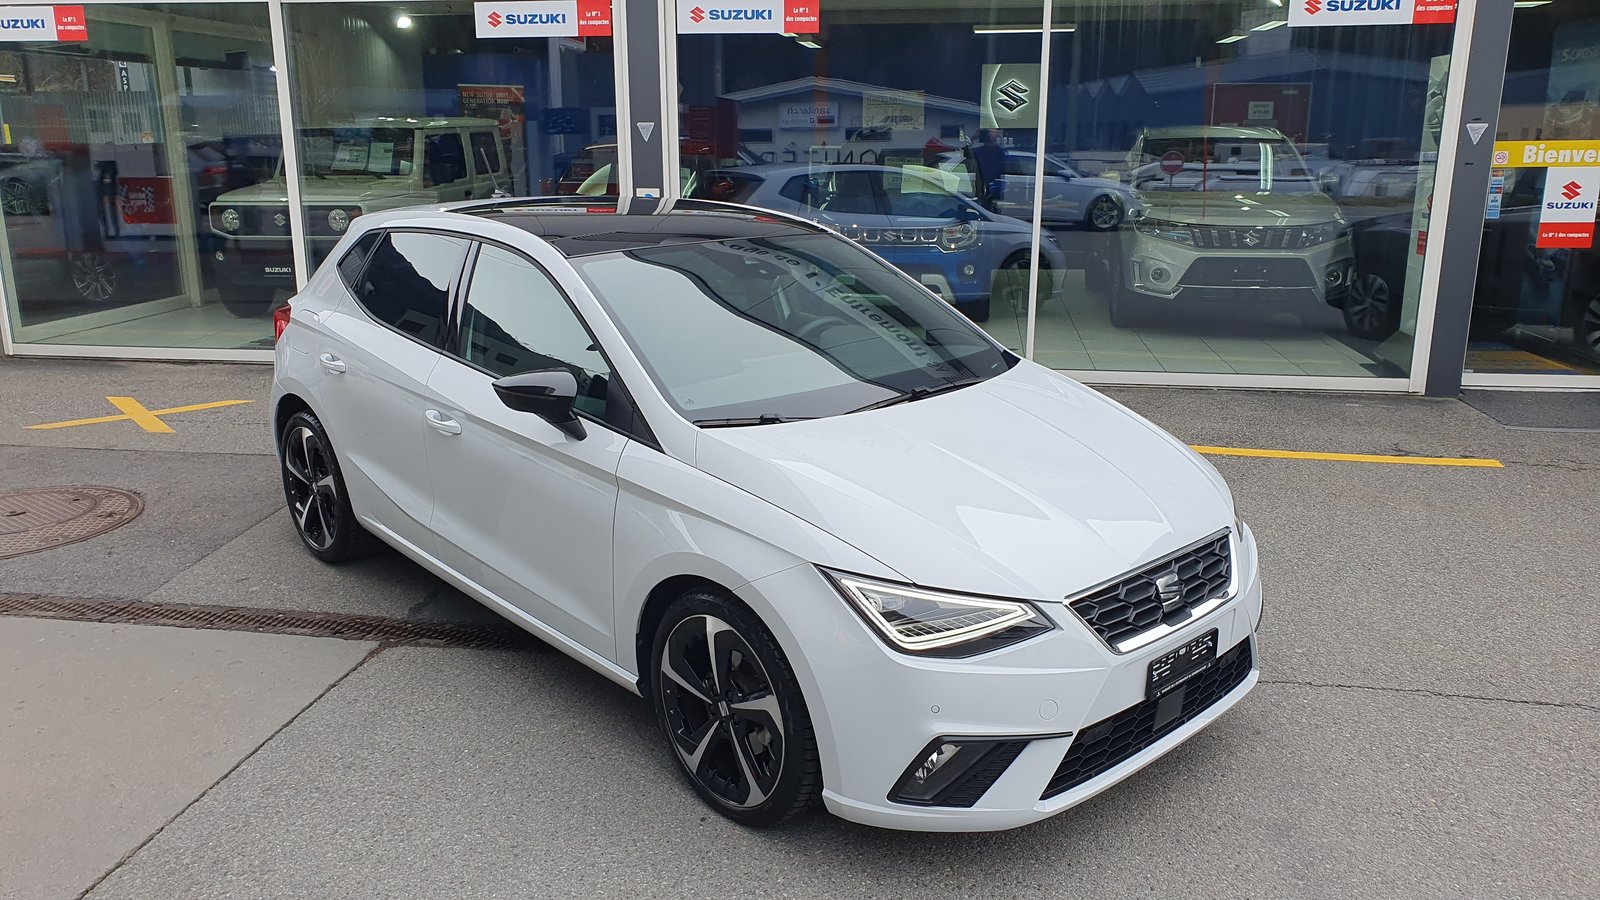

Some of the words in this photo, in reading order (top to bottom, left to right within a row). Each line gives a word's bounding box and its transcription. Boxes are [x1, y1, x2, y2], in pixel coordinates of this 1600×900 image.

[1426, 4, 1453, 12] compactes
[505, 13, 566, 25] SUZUKI
[708, 9, 773, 20] SUZUKI
[0, 18, 46, 29] UZUKI
[1522, 143, 1600, 164] Bienve
